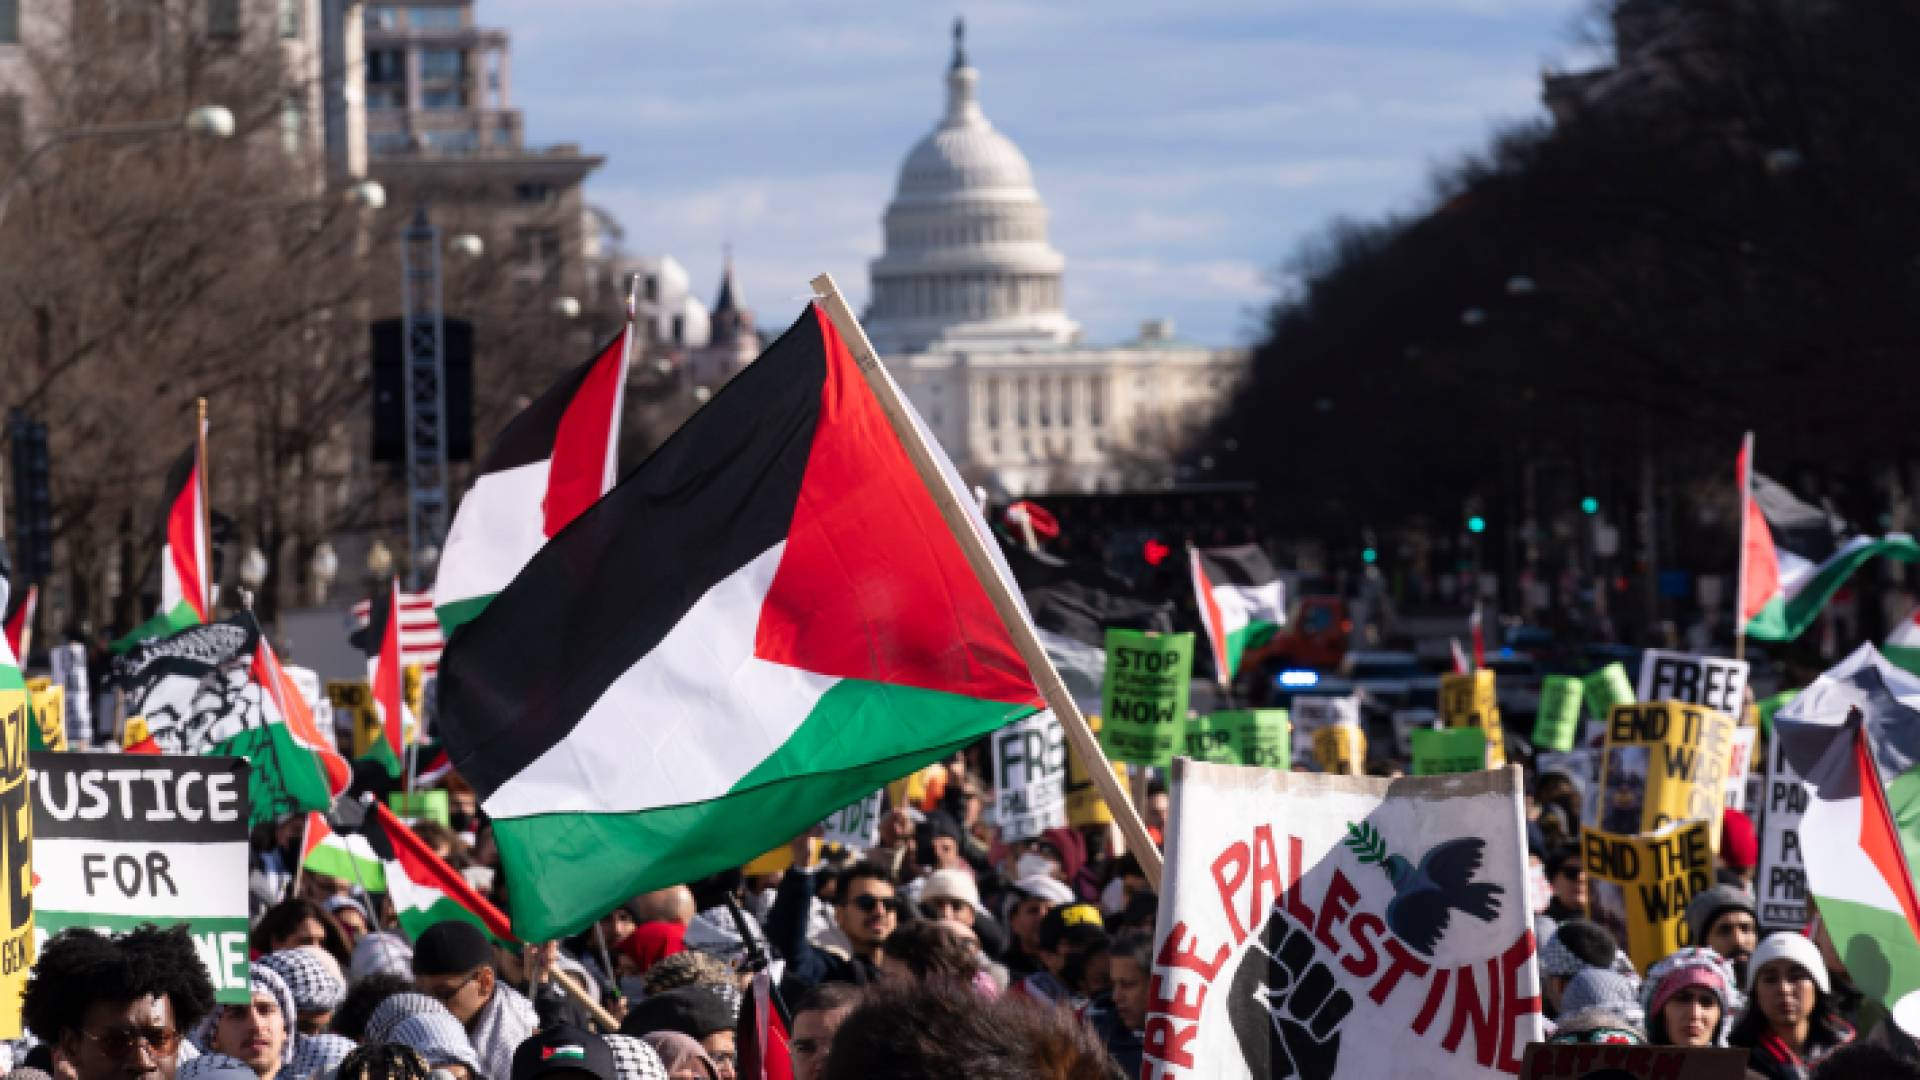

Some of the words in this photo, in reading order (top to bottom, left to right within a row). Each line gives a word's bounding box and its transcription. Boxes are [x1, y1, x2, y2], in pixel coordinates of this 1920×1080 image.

[1116, 646, 1179, 673] STOP
[1652, 657, 1739, 712] FREE
[1112, 698, 1176, 724] NOW
[1611, 706, 1669, 743] END
[28, 769, 239, 822] USTICE
[81, 850, 178, 899] FOR
[1584, 831, 1639, 881] END
[1649, 825, 1708, 881] THE
[1639, 872, 1708, 924] WAR
[1210, 823, 1542, 1075] PALESTINE
